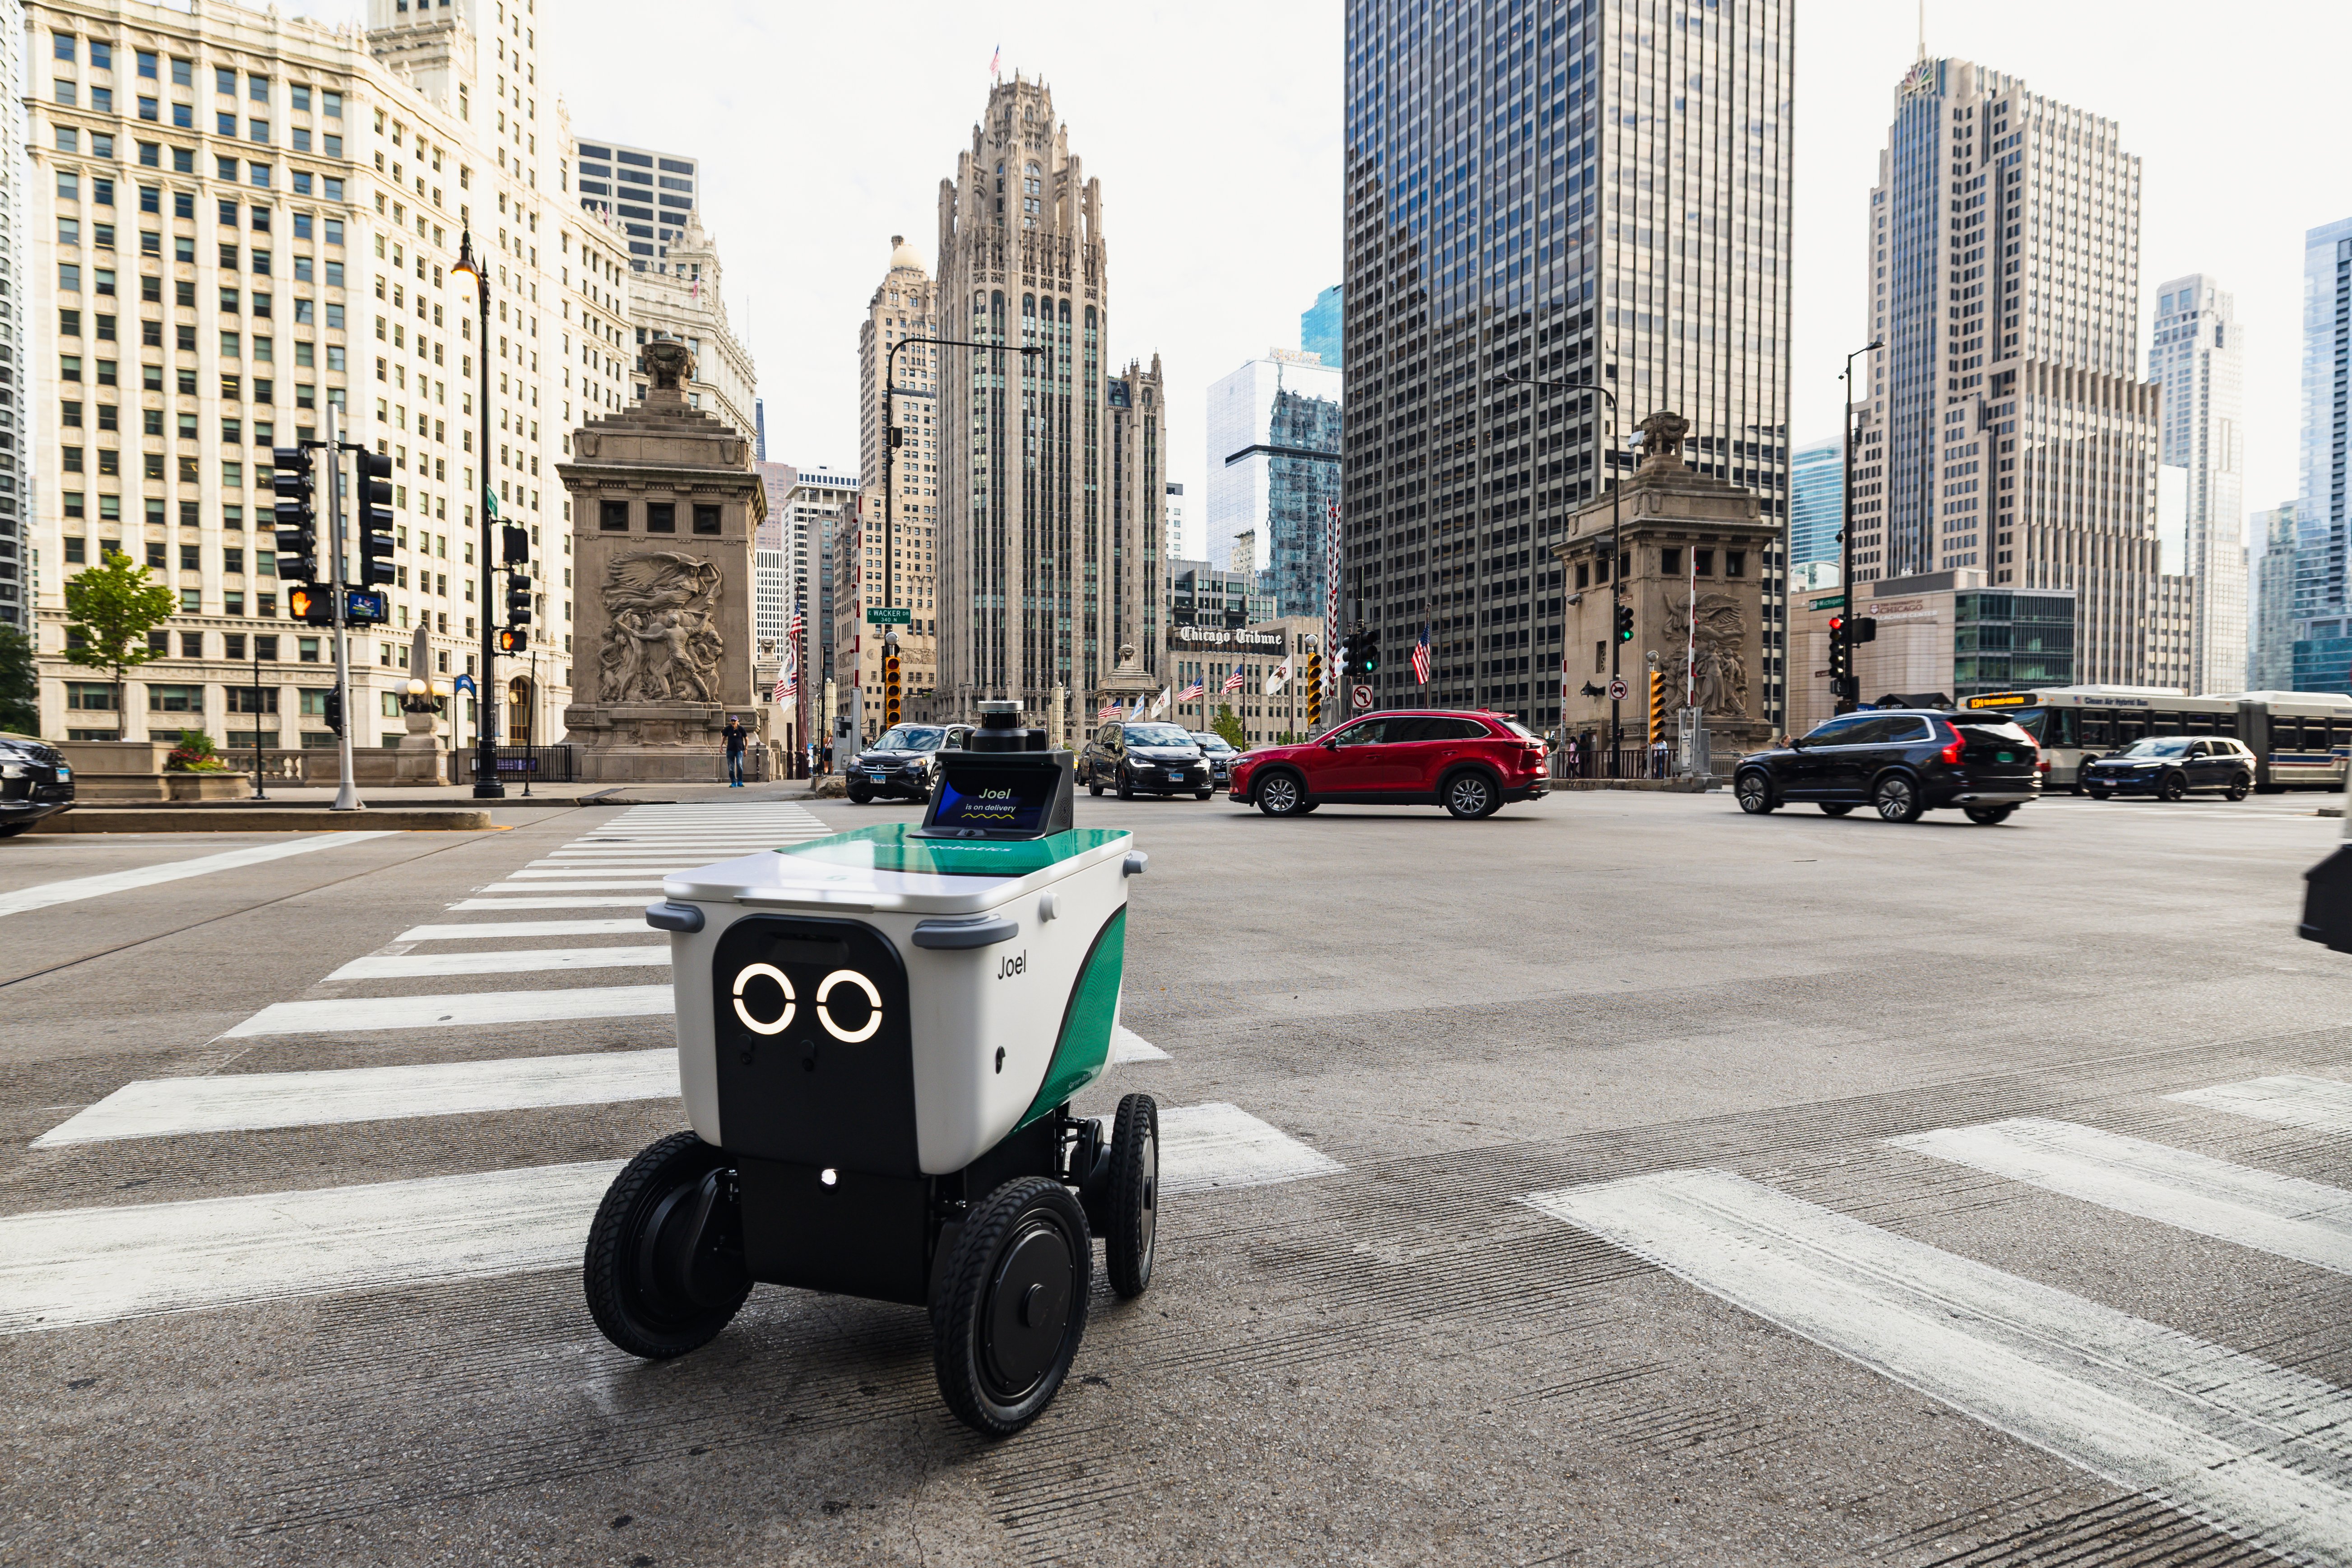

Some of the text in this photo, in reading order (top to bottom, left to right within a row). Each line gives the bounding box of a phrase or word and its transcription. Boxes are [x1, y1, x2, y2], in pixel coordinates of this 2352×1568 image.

[612, 439, 710, 452] CITY OF CHICAGO
[1880, 604, 1923, 614] CHICAGO
[1180, 626, 1282, 645] Chicago Tribune
[2084, 696, 2102, 705] Clean
[979, 788, 1011, 799] Joel
[985, 804, 1016, 813] delivery
[997, 949, 1026, 980] Joel
